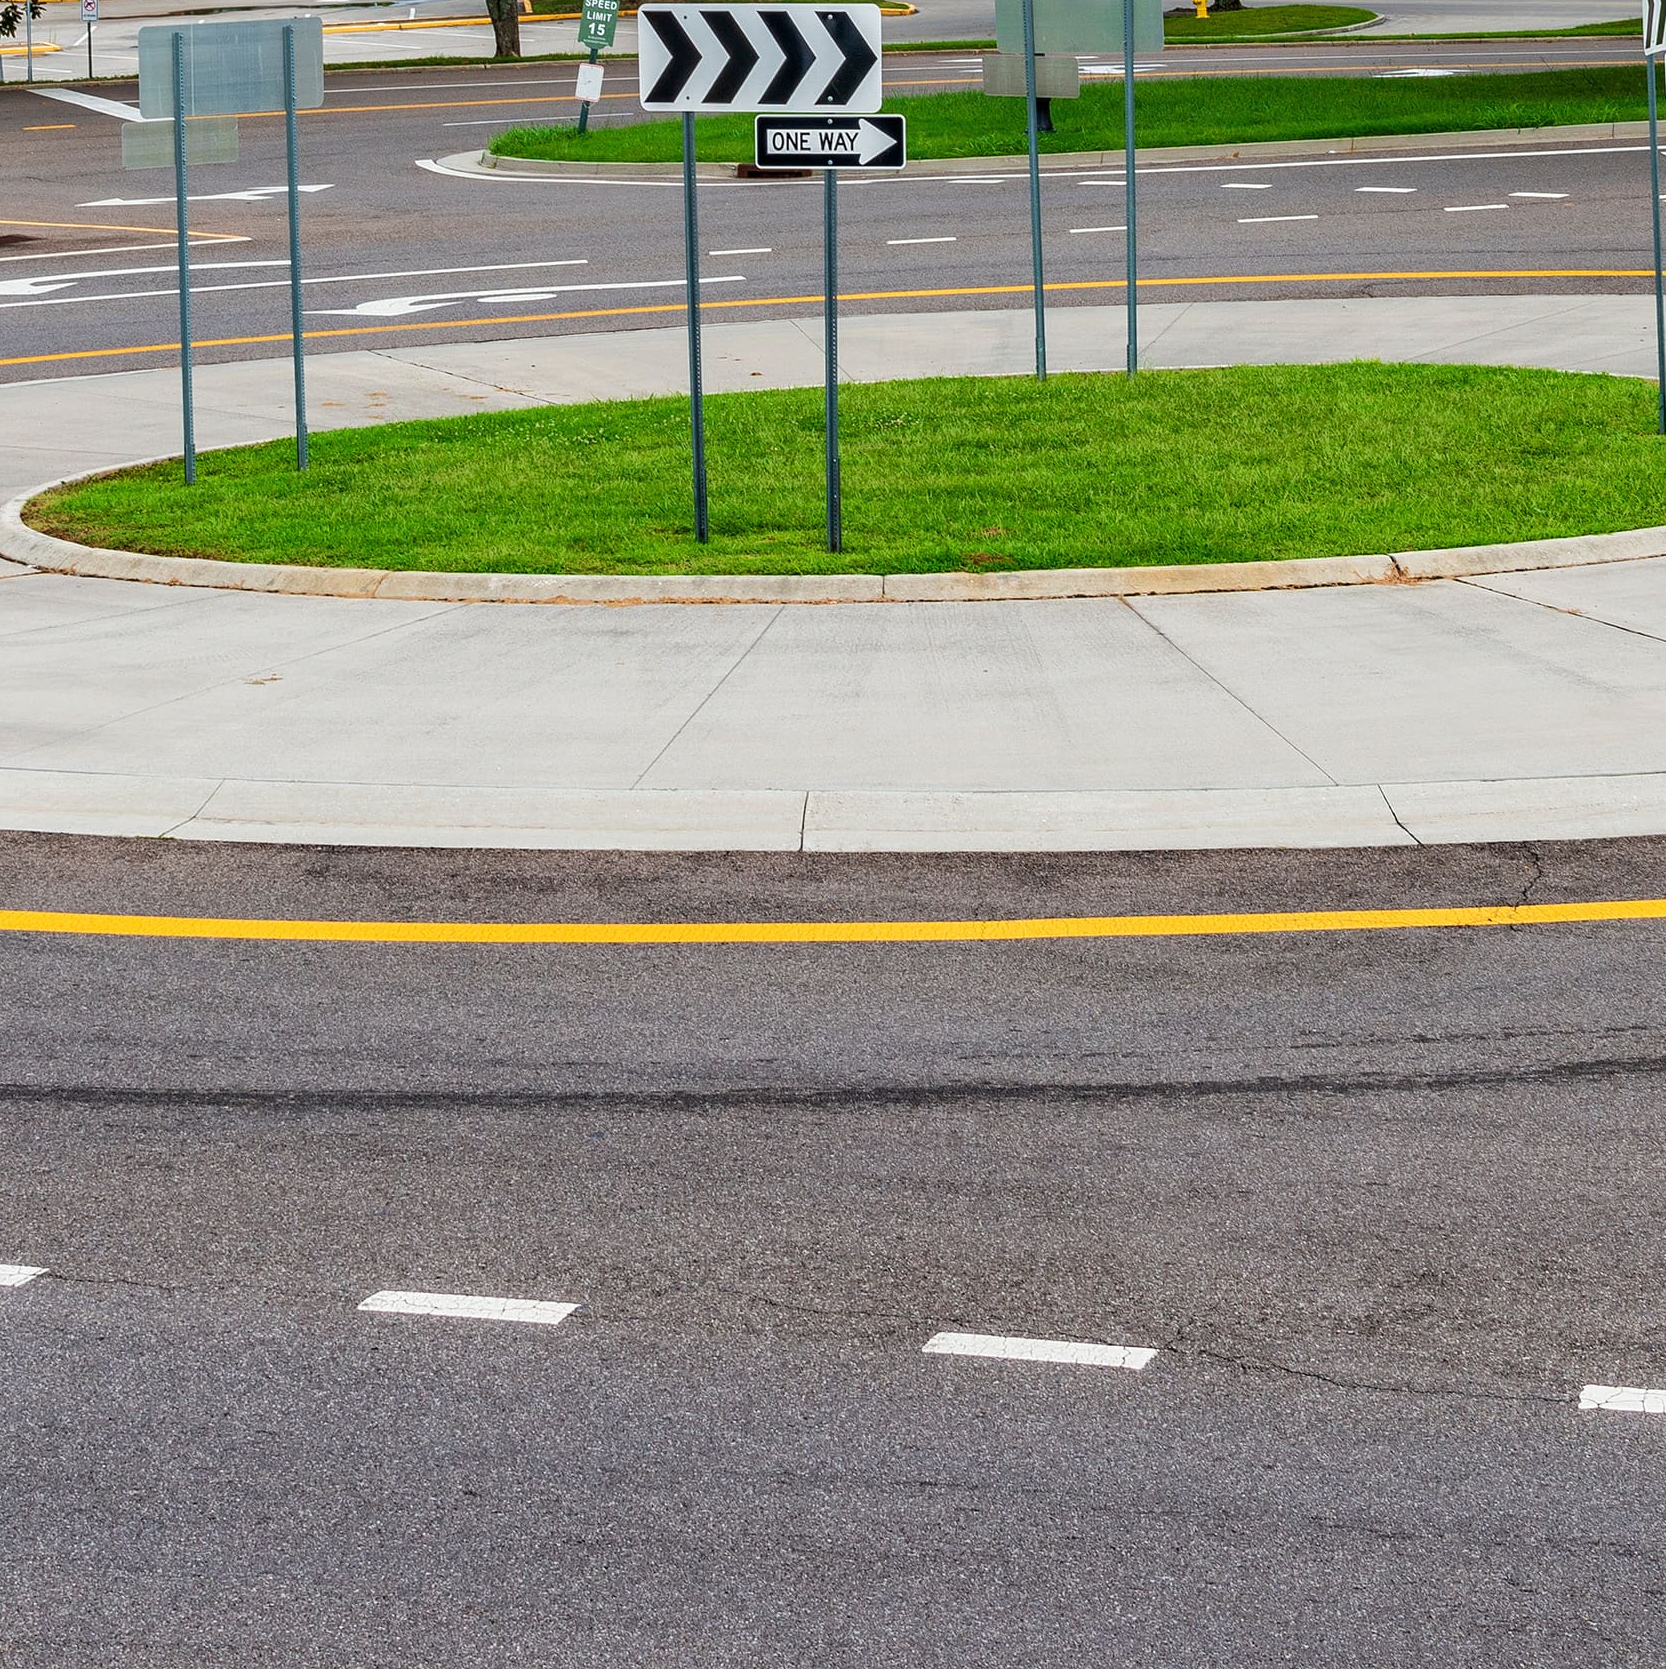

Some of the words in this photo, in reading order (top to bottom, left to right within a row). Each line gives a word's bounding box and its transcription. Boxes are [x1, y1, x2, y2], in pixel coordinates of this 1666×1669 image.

[587, 11, 612, 22] LIMIT
[589, 23, 605, 36] 15
[772, 132, 811, 151] ONE
[819, 132, 859, 151] WAY
